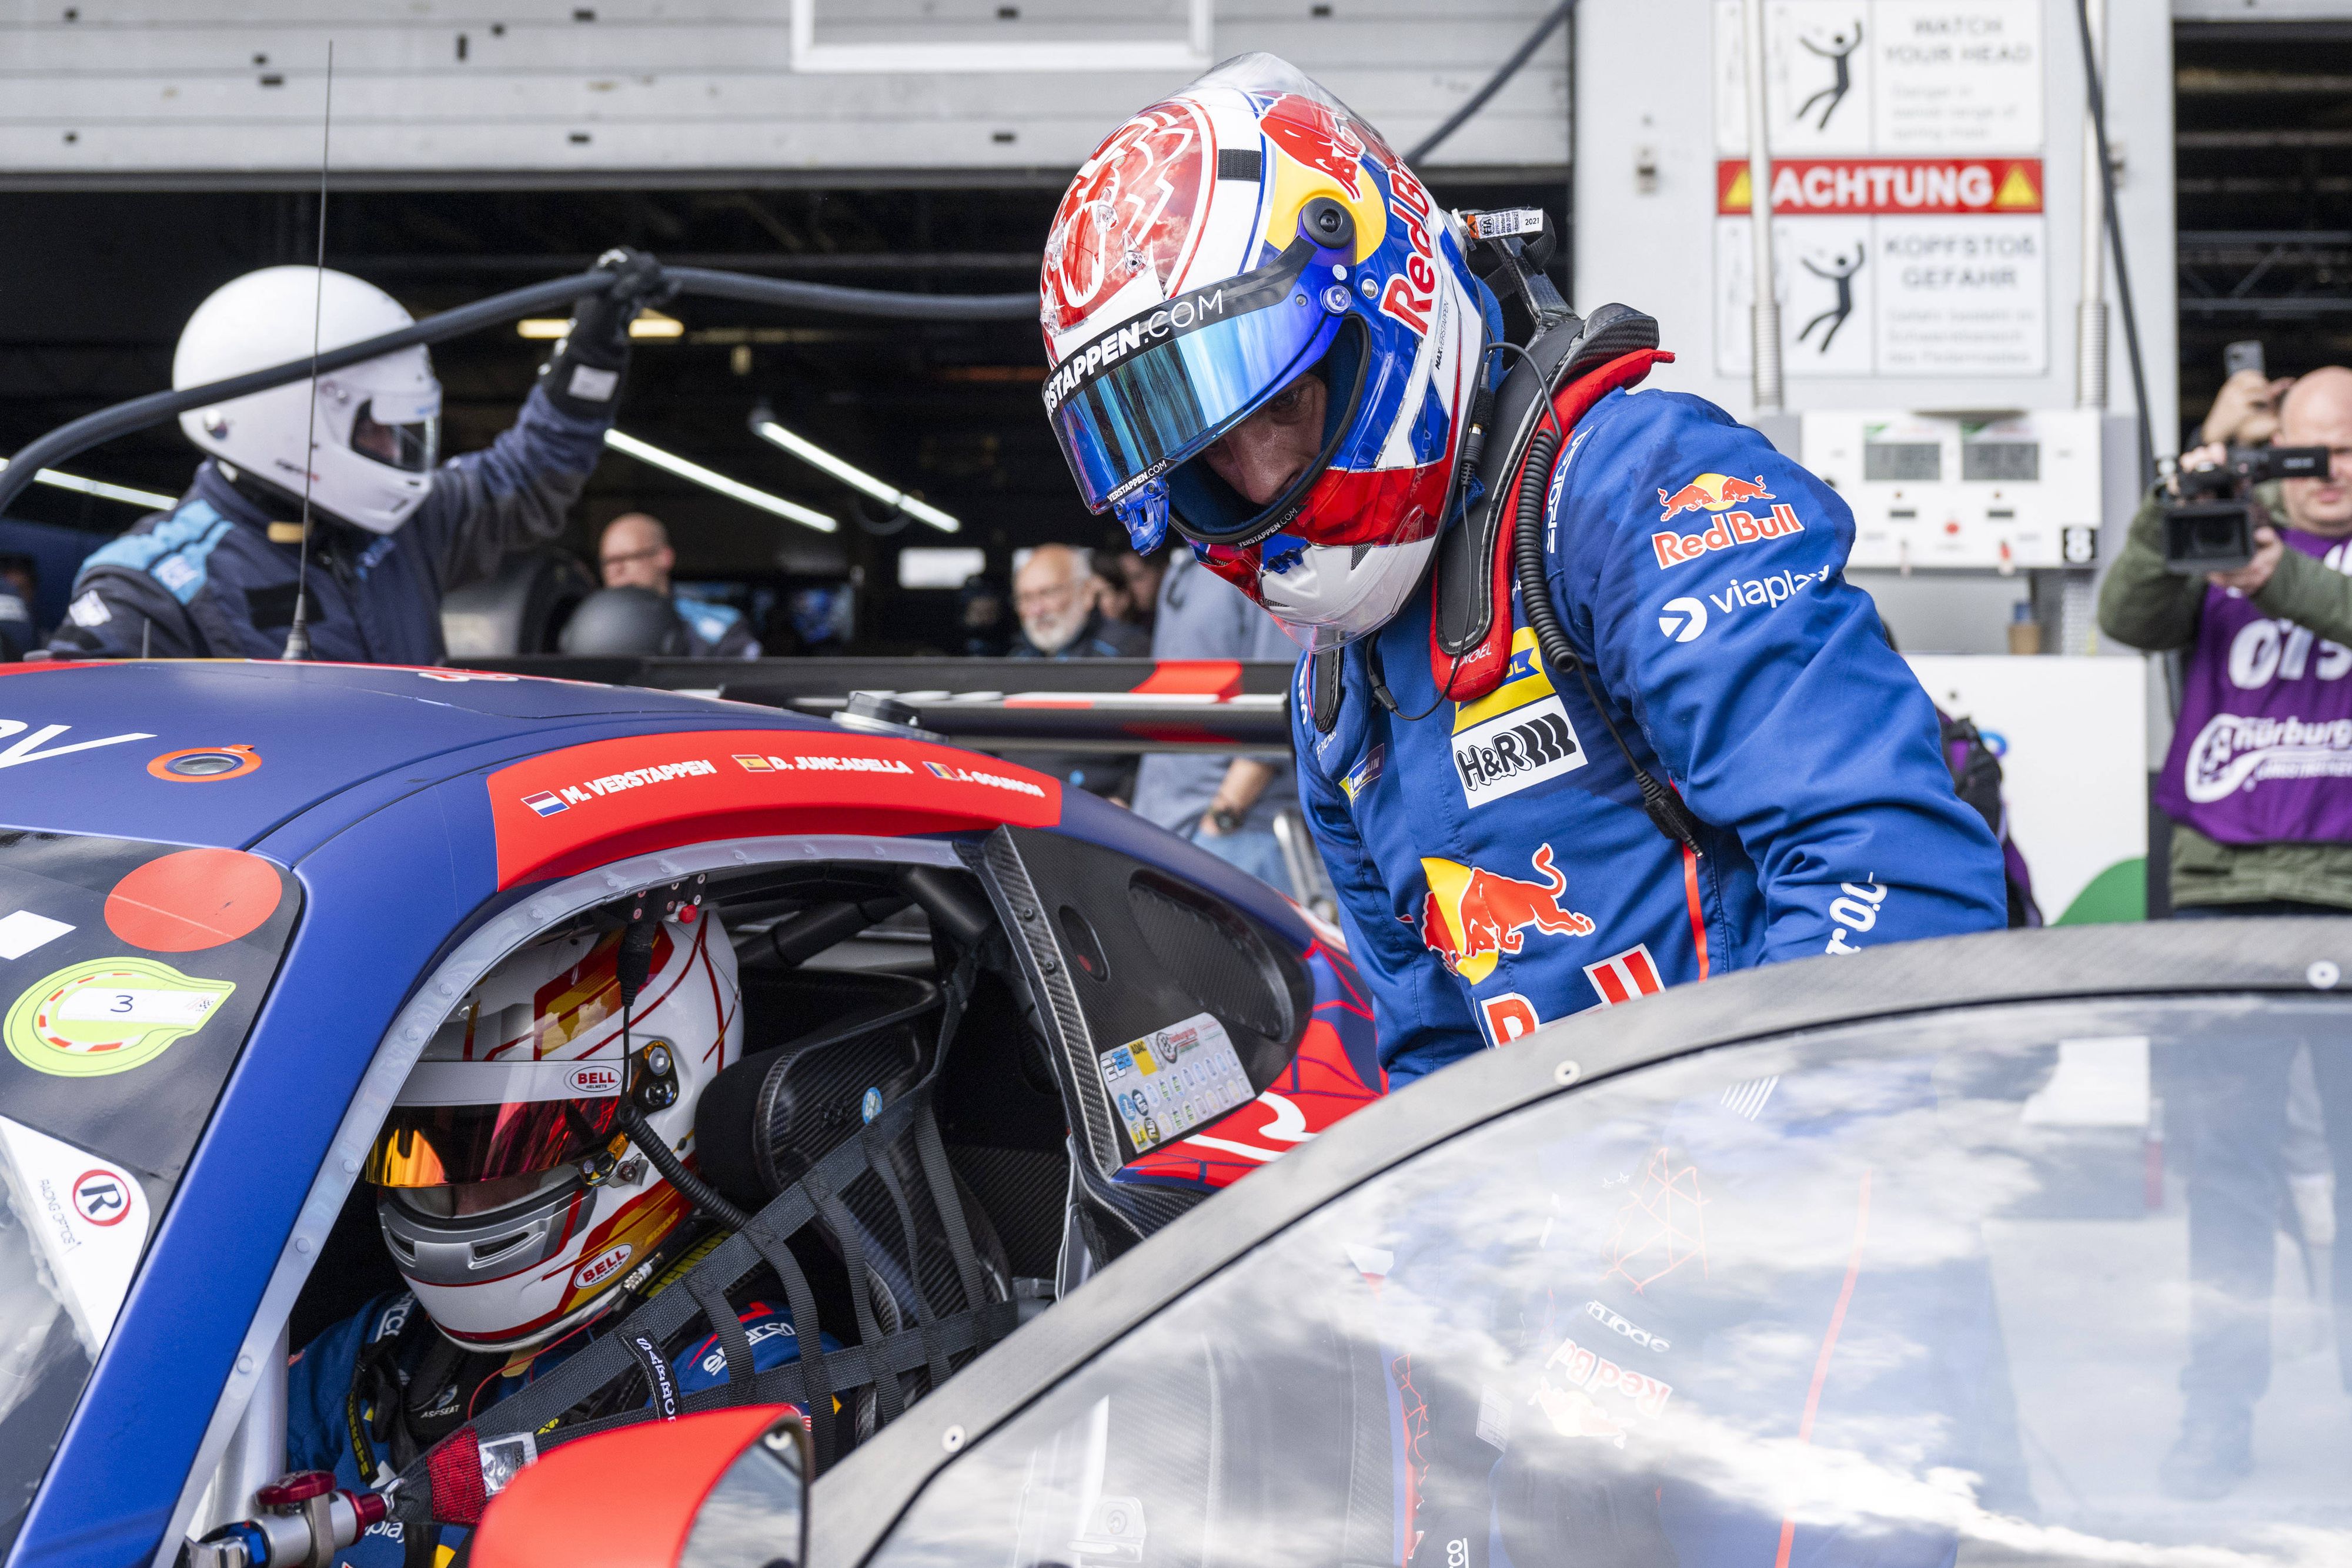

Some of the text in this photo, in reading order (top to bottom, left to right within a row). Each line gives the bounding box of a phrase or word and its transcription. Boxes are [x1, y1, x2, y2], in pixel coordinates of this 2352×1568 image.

[1884, 44, 2031, 64] YOUR HEAD
[1770, 166, 1993, 208] ACHTUNG
[1482, 218, 1492, 235] FIA
[1525, 218, 1539, 226] 2021
[1902, 268, 2017, 289] GEFAHR
[1107, 460, 1167, 503] VERSTAPPEN.COM
[1238, 507, 1298, 547] VERSTAPPEN.COM
[2064, 527, 2094, 563] 8
[767, 755, 914, 774] D. JUNCADELLA
[1456, 732, 1532, 792] H&R
[560, 759, 718, 805] M. VERSTAPPEN
[110, 995, 133, 1012] 3
[578, 1072, 615, 1084] BELL
[39, 1178, 62, 1212] RACING
[80, 1183, 122, 1215] R
[583, 1251, 626, 1283] BELL
